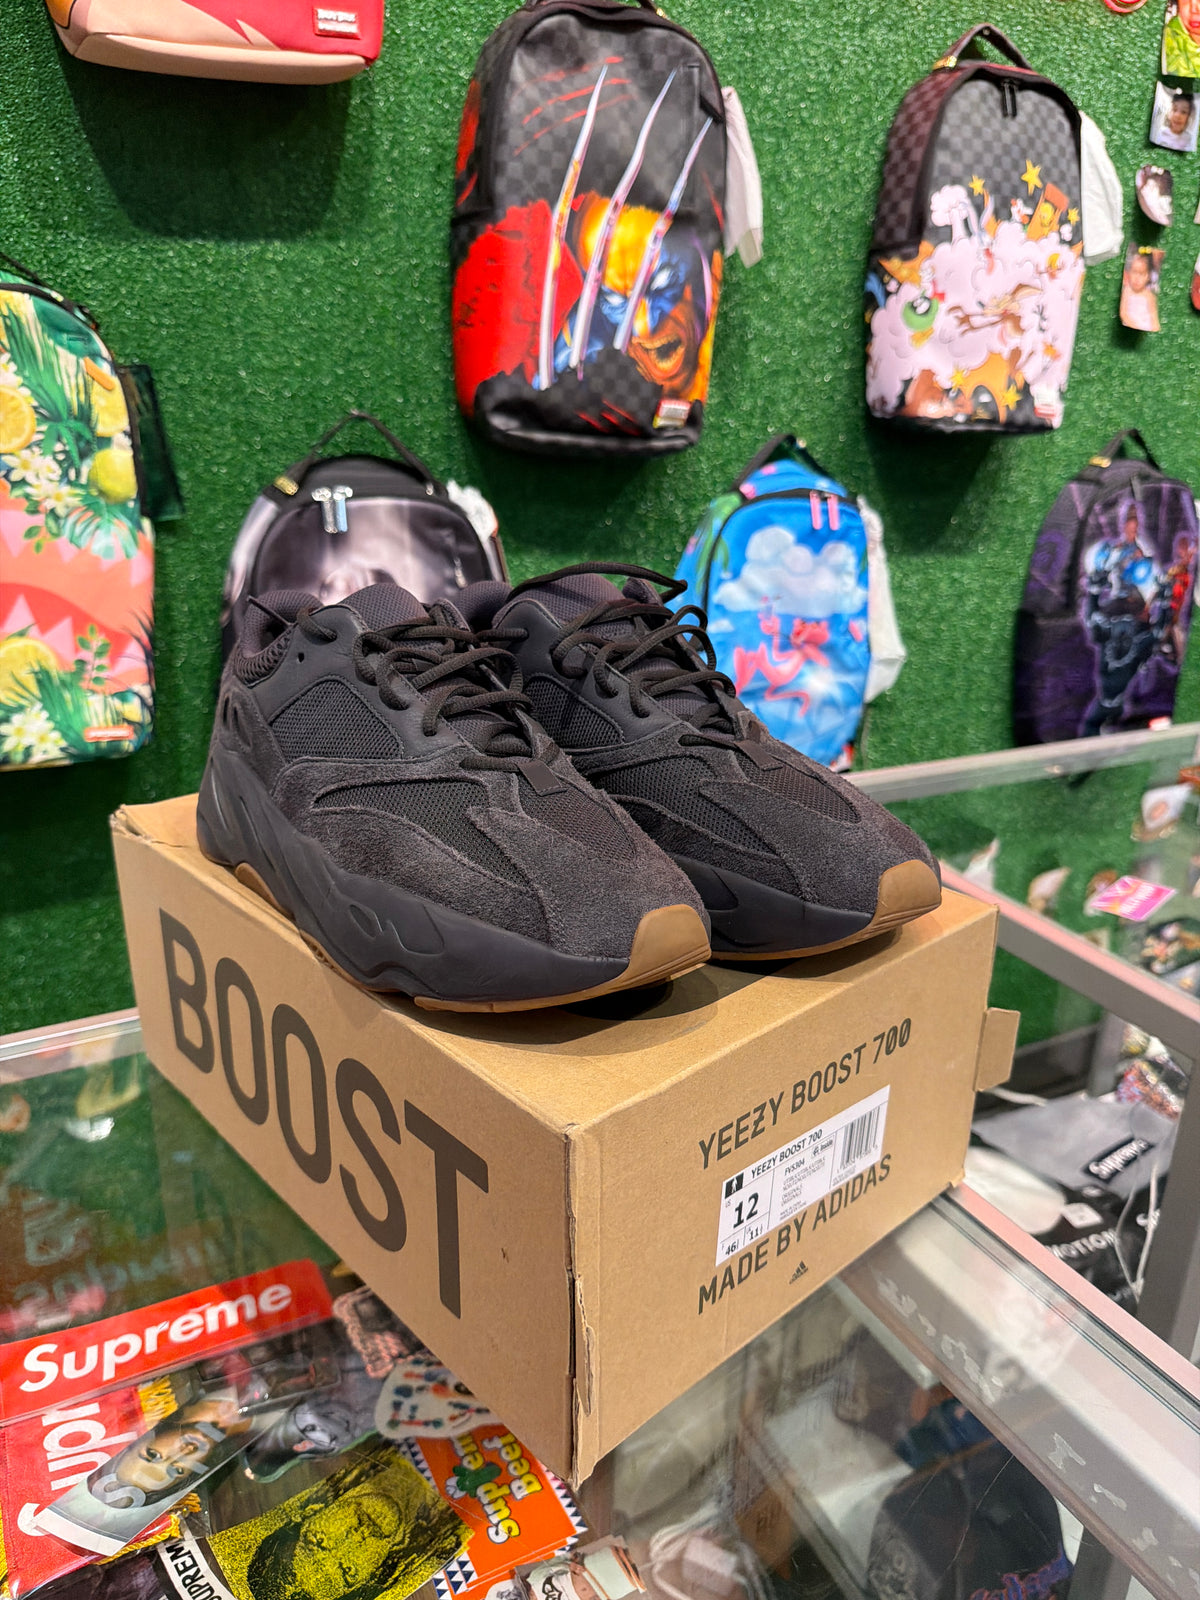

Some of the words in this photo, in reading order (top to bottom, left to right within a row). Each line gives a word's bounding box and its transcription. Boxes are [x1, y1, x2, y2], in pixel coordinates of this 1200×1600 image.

[159, 907, 489, 1319] BOOST
[698, 1091, 784, 1170] YEEZY
[790, 1043, 867, 1114] BOOST
[873, 1018, 912, 1064] 700
[751, 1155, 777, 1179] YEEZY
[780, 1138, 806, 1162] BOOST
[807, 1129, 823, 1145] 700
[698, 1238, 769, 1315] MADE
[776, 1210, 808, 1257] BY
[812, 1154, 892, 1231] ADIDAS
[733, 1192, 759, 1229] 12
[19, 1283, 292, 1392] Supreme
